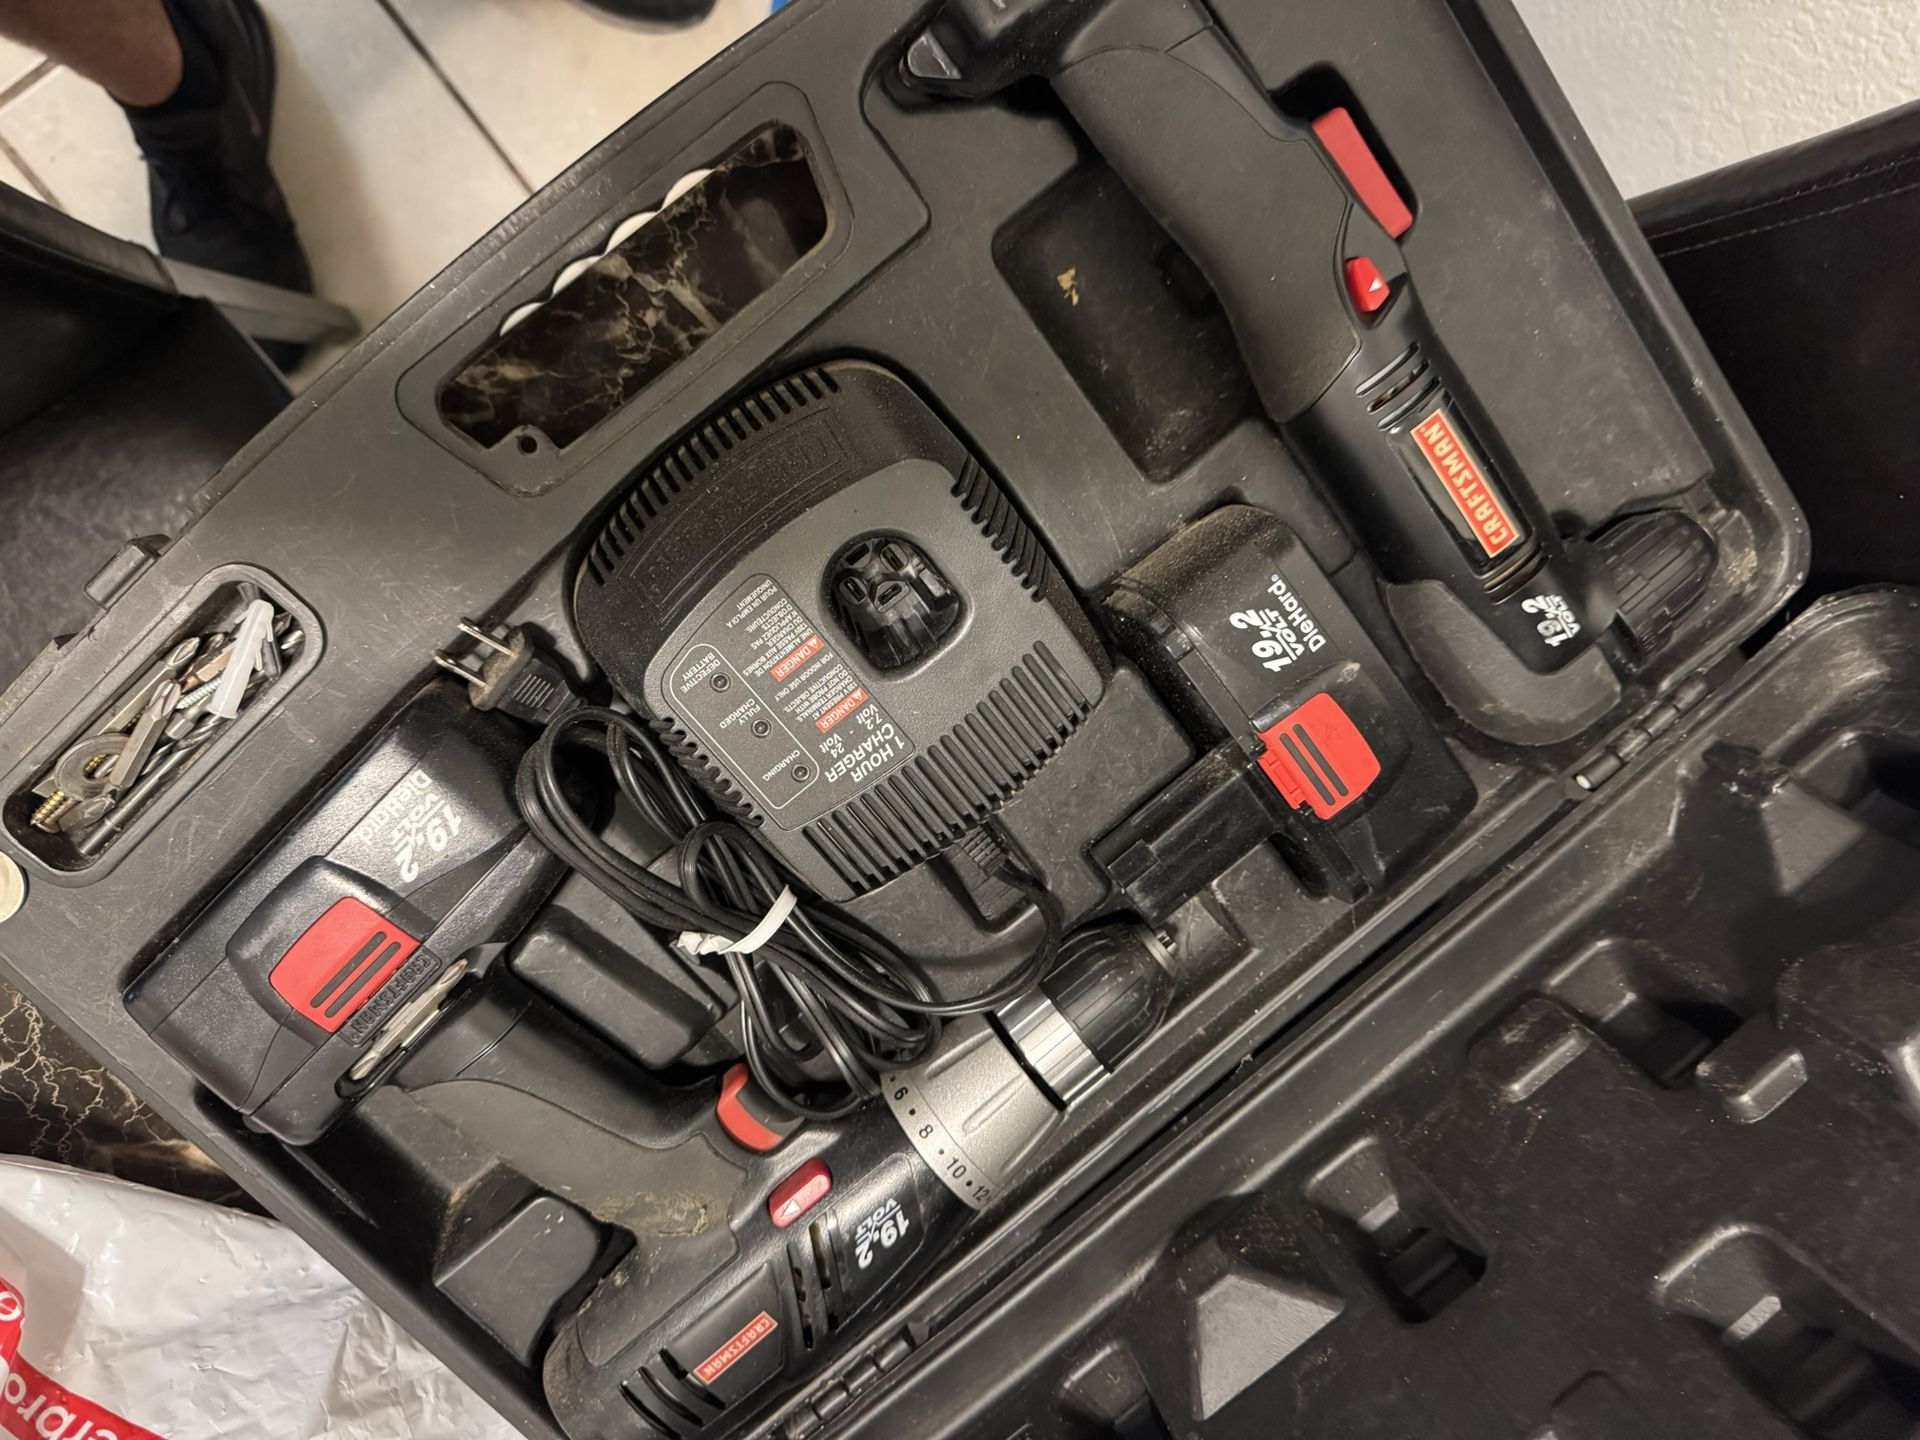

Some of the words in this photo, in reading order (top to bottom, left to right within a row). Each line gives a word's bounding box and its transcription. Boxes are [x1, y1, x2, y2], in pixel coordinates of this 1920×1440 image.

[1423, 422, 1508, 545] CRAFTSMAN
[736, 579, 773, 611] UNIQUEMENT
[751, 598, 762, 608] UN
[759, 585, 778, 602] POUR
[731, 605, 754, 625] EMPLOI
[761, 603, 793, 631] D'OBJECTS
[761, 610, 798, 641] N'APPLIQUEZ
[792, 615, 803, 626] DU
[1521, 595, 1568, 647] 19.2
[1549, 594, 1581, 635] VOLT
[750, 637, 764, 650] PAS
[775, 632, 796, 650] PASSE
[799, 628, 814, 640] UNE
[1229, 609, 1292, 672] 19.2
[1264, 608, 1305, 656] VOLT
[762, 637, 801, 671] ALIMENTATION
[764, 646, 777, 659] AUX
[774, 645, 812, 677] DANGER
[819, 651, 834, 665] FOR
[680, 658, 721, 693] DEFECTIVE
[682, 652, 715, 682] BATTERY
[742, 655, 767, 677] BORNES
[754, 667, 765, 677] DE
[799, 661, 822, 681] INDOOR
[838, 669, 849, 679] DO
[787, 678, 802, 691] USE
[807, 663, 843, 694] CONDUCTIVE
[825, 675, 853, 699] CHARGER
[827, 676, 840, 689] NOT
[774, 687, 790, 702] ONLY
[808, 685, 829, 704] PROBE
[819, 692, 845, 715] PRESENT
[719, 698, 755, 729] CHARGED
[738, 704, 761, 726] FULLY
[795, 700, 811, 714] WITH
[812, 711, 820, 720] AT
[819, 697, 856, 729] DANGER
[855, 703, 879, 725] Volt
[864, 713, 883, 730] 7.2
[819, 733, 843, 754] Volt
[824, 723, 895, 783] CHARGER
[830, 742, 845, 759] 24
[894, 735, 905, 750] 1
[762, 749, 801, 782] CHARGING
[850, 743, 894, 783] HOUR
[359, 769, 433, 846] DieHard
[390, 793, 440, 846] VOLT
[394, 804, 461, 882] 19.2
[350, 954, 432, 1034] CRAFTSMAN
[894, 1086, 908, 1101] 6
[919, 1124, 933, 1139] 8
[946, 1157, 967, 1179] 10
[972, 1185, 990, 1201] 12
[854, 1198, 897, 1241] VOLT
[855, 1210, 910, 1269] 19.2
[703, 1317, 770, 1376] CRAFTSMAN
